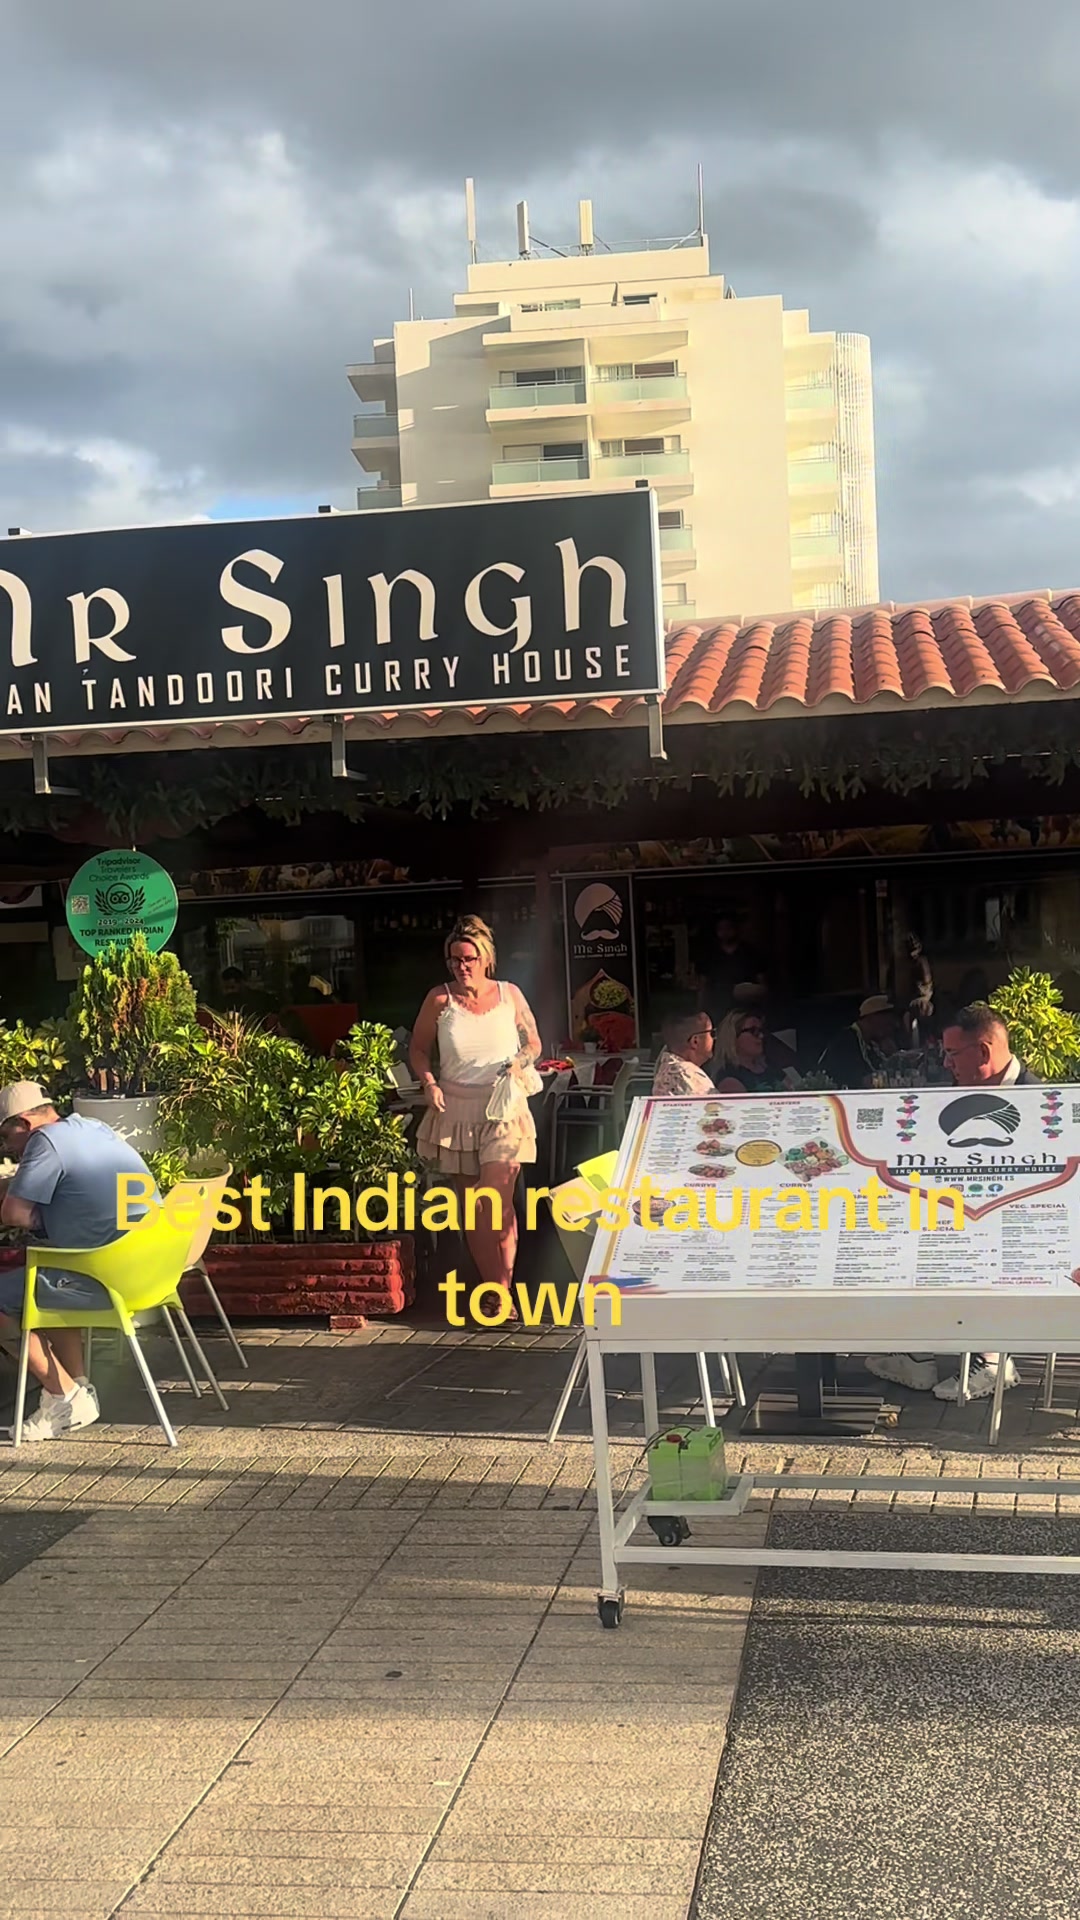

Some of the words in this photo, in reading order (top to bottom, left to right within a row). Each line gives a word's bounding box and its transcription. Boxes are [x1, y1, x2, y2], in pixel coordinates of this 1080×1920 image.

[82, 667, 293, 711] TANDOORI
[325, 656, 460, 696] CURRY
[493, 645, 631, 685] HOUSE
[96, 857, 141, 866] Tripadvisor
[89, 874, 119, 882] Choice
[120, 872, 150, 881] Awards
[80, 929, 97, 937] TOP
[98, 927, 133, 936] RANKED
